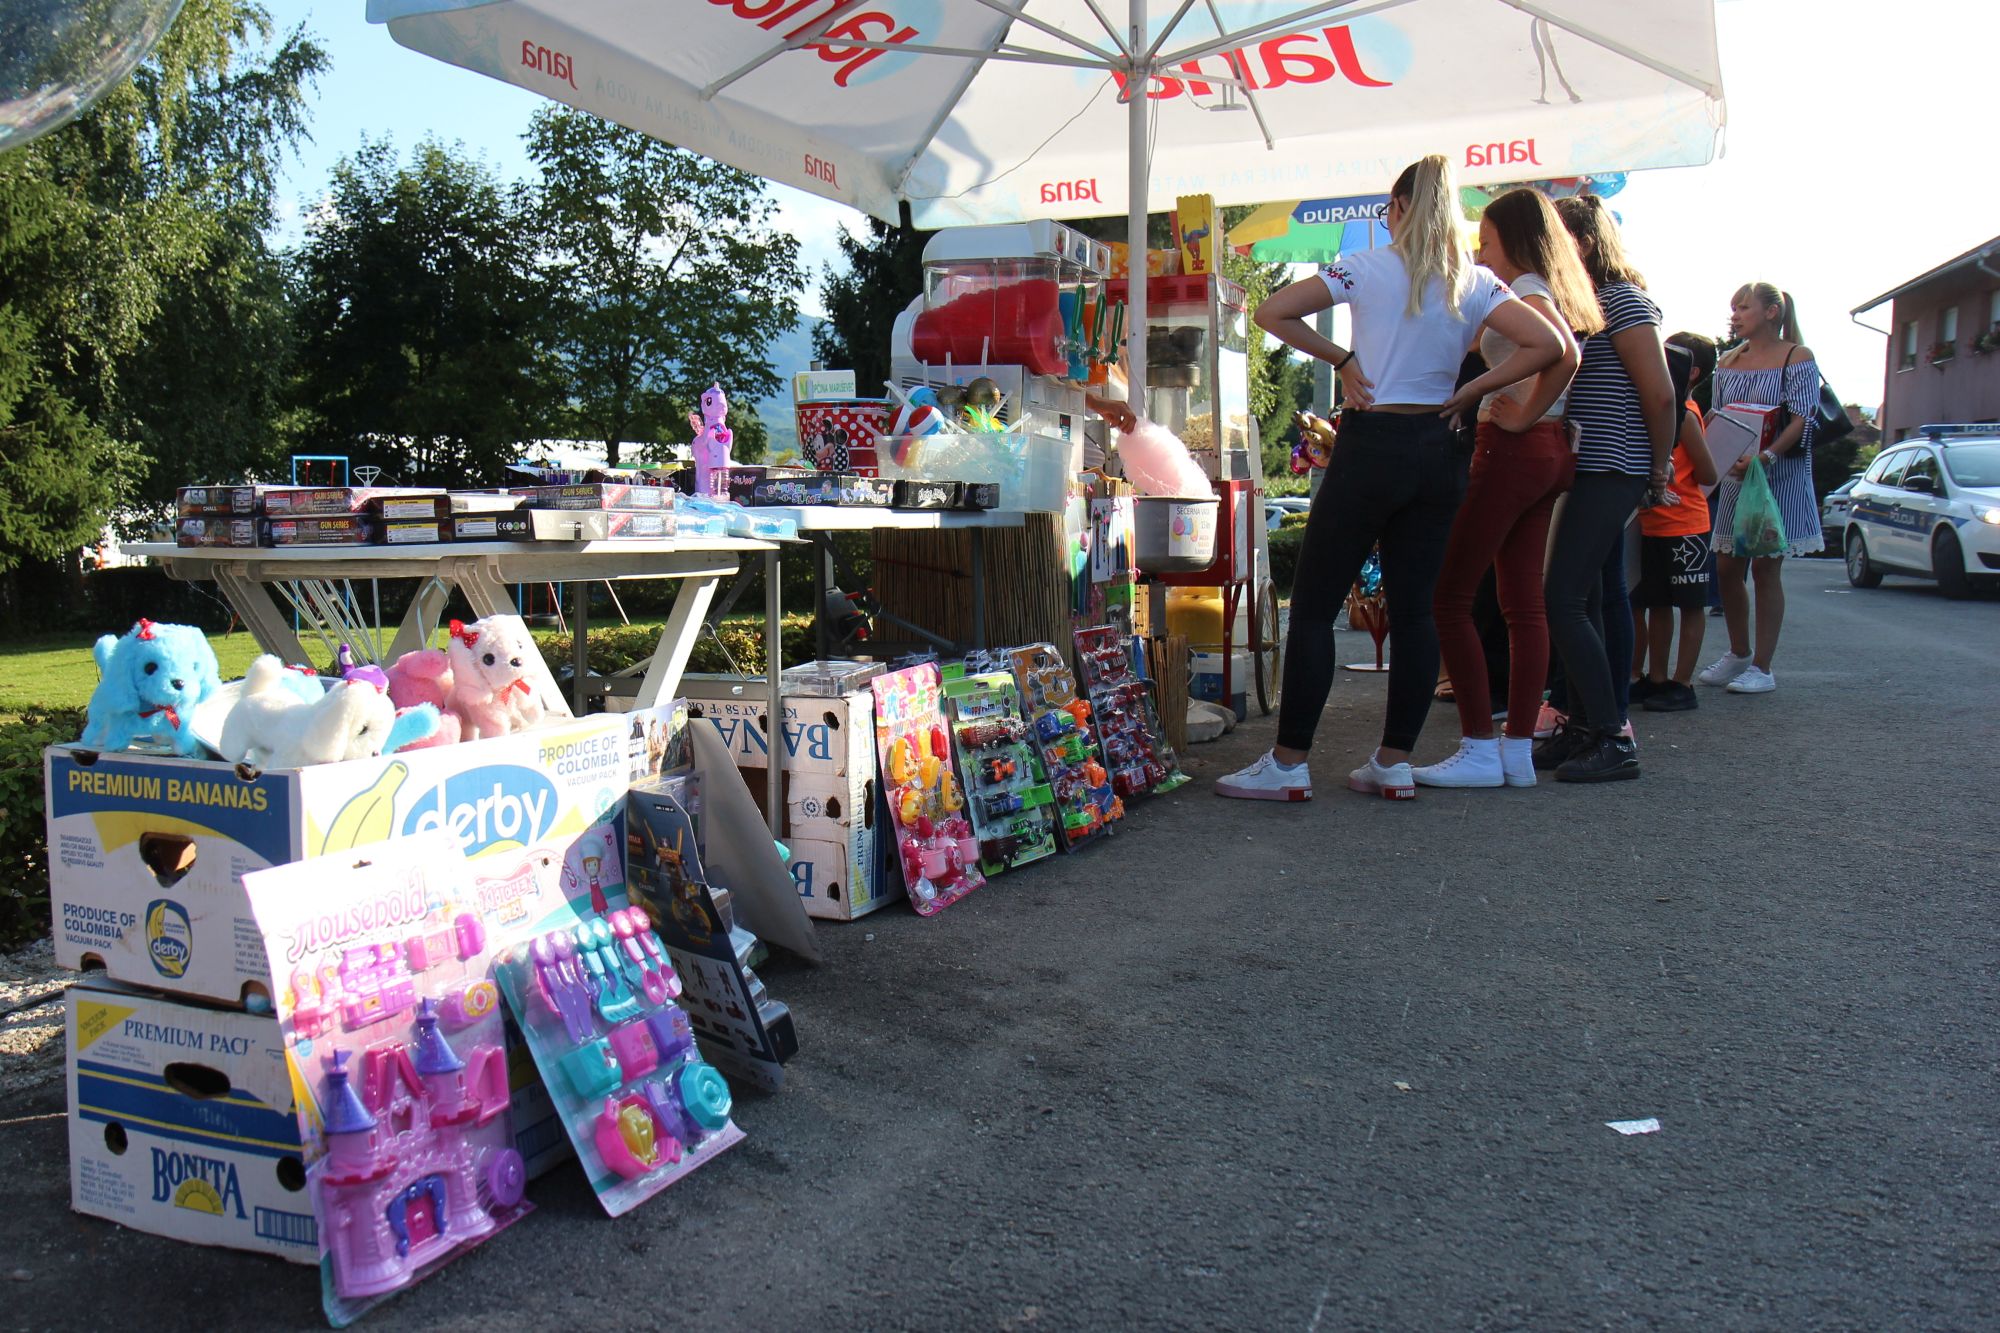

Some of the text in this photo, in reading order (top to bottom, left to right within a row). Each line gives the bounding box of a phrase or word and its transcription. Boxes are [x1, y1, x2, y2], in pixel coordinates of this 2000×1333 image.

[1303, 202, 1388, 223] DURANG
[314, 491, 326, 500] GUN
[767, 481, 807, 494] BARREL
[320, 521, 332, 529] GUN
[725, 704, 739, 715] 58
[742, 705, 758, 716] AT
[538, 736, 618, 763] PRODUCE OF
[708, 717, 833, 761] BANA
[557, 752, 620, 776] COLOMBIA
[567, 770, 617, 787] VACUUM PACK
[69, 770, 268, 811] PREMIUM BANANAS
[414, 778, 548, 850] derby
[63, 903, 136, 927] PRODUCE OF
[64, 918, 123, 939] COLOMBIA
[65, 933, 112, 950] VACUUM PACK
[153, 938, 186, 961] derby
[124, 1019, 203, 1049] PREMIUM
[150, 1147, 249, 1220] BONITA
